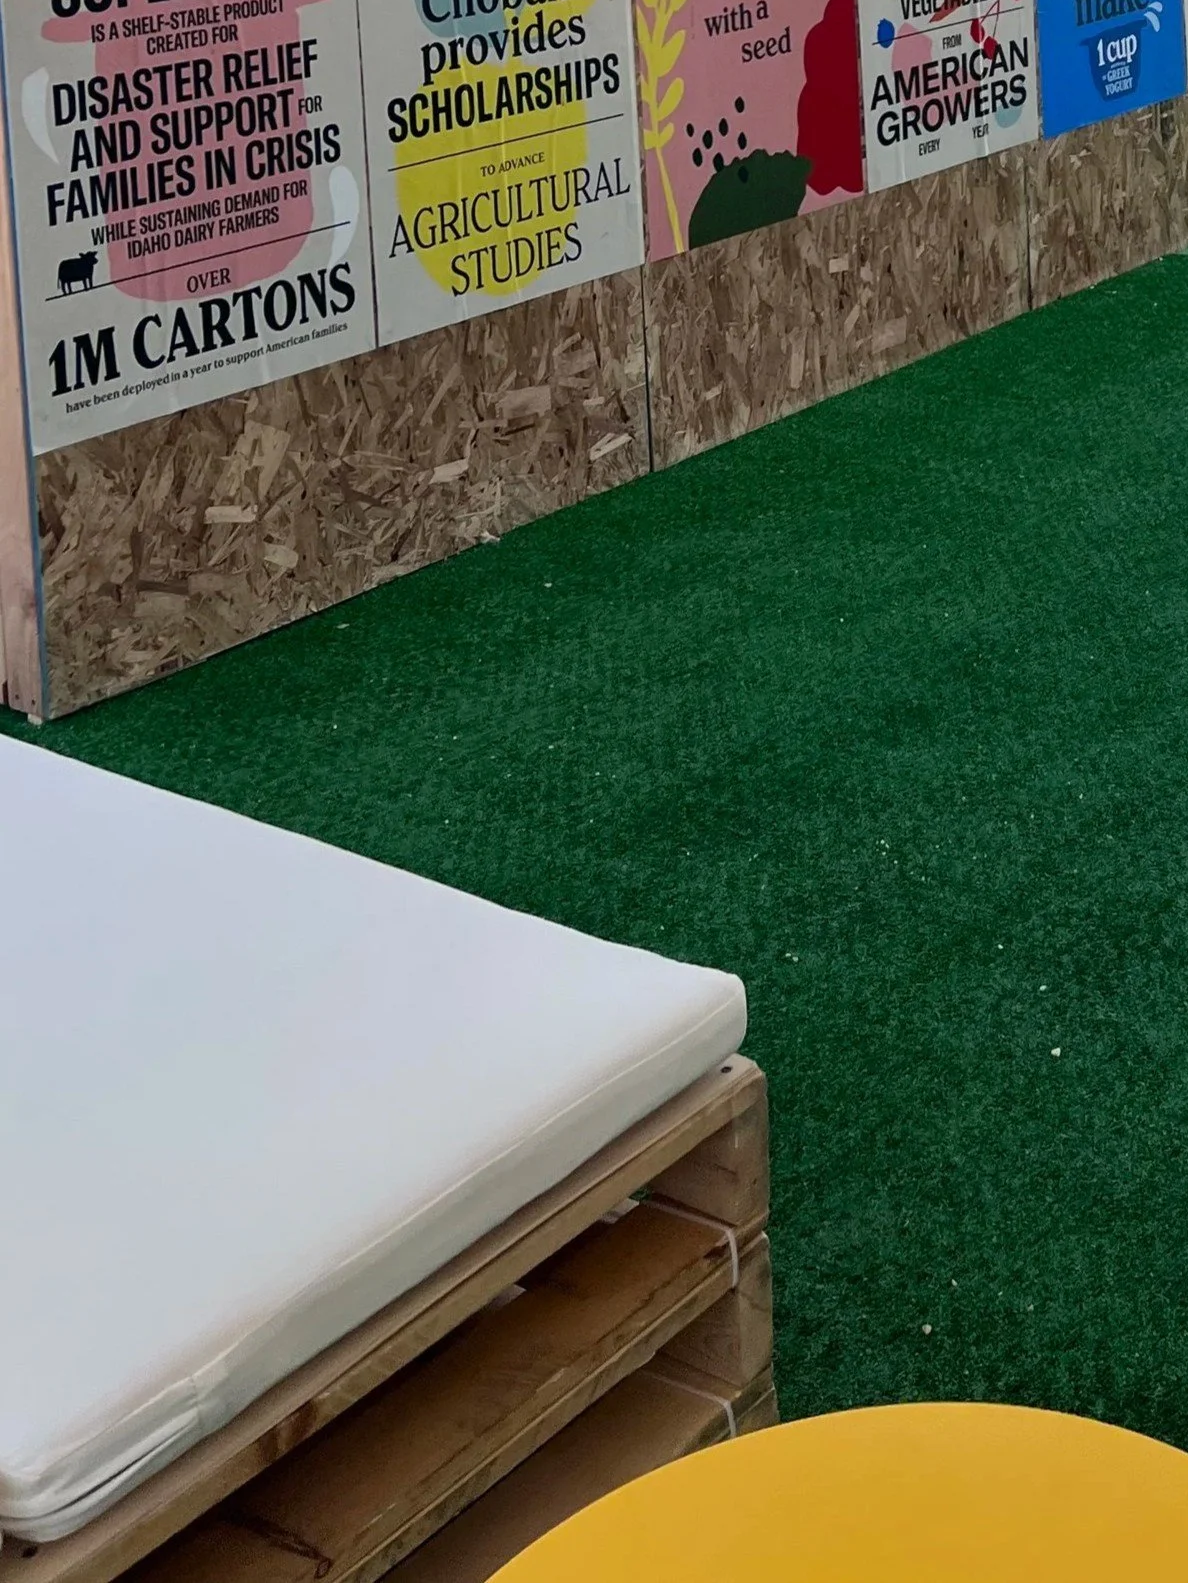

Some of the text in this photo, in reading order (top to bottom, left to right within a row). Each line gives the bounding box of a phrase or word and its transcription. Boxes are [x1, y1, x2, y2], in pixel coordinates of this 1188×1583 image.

[421, 9, 586, 86] provides
[704, 2, 754, 37] with
[741, 28, 792, 63] seed
[1096, 32, 1138, 67] 1 cup
[52, 39, 318, 127] DISASTER RELIEF
[387, 53, 620, 143] SCHOLARSHIPS
[870, 37, 1029, 111] AMERICAN
[876, 74, 1027, 147] GROWERS
[1105, 77, 1133, 96] YOGURT
[1107, 67, 1131, 82] GREEK
[70, 89, 323, 173] AND SUPPORT FOR
[46, 124, 341, 227] FAMILIES IN CRISIS
[388, 157, 631, 258] AGRICULTURAL
[186, 267, 231, 293] OVER
[451, 221, 582, 297] STUDIES
[49, 262, 356, 397] 1M CARTONS
